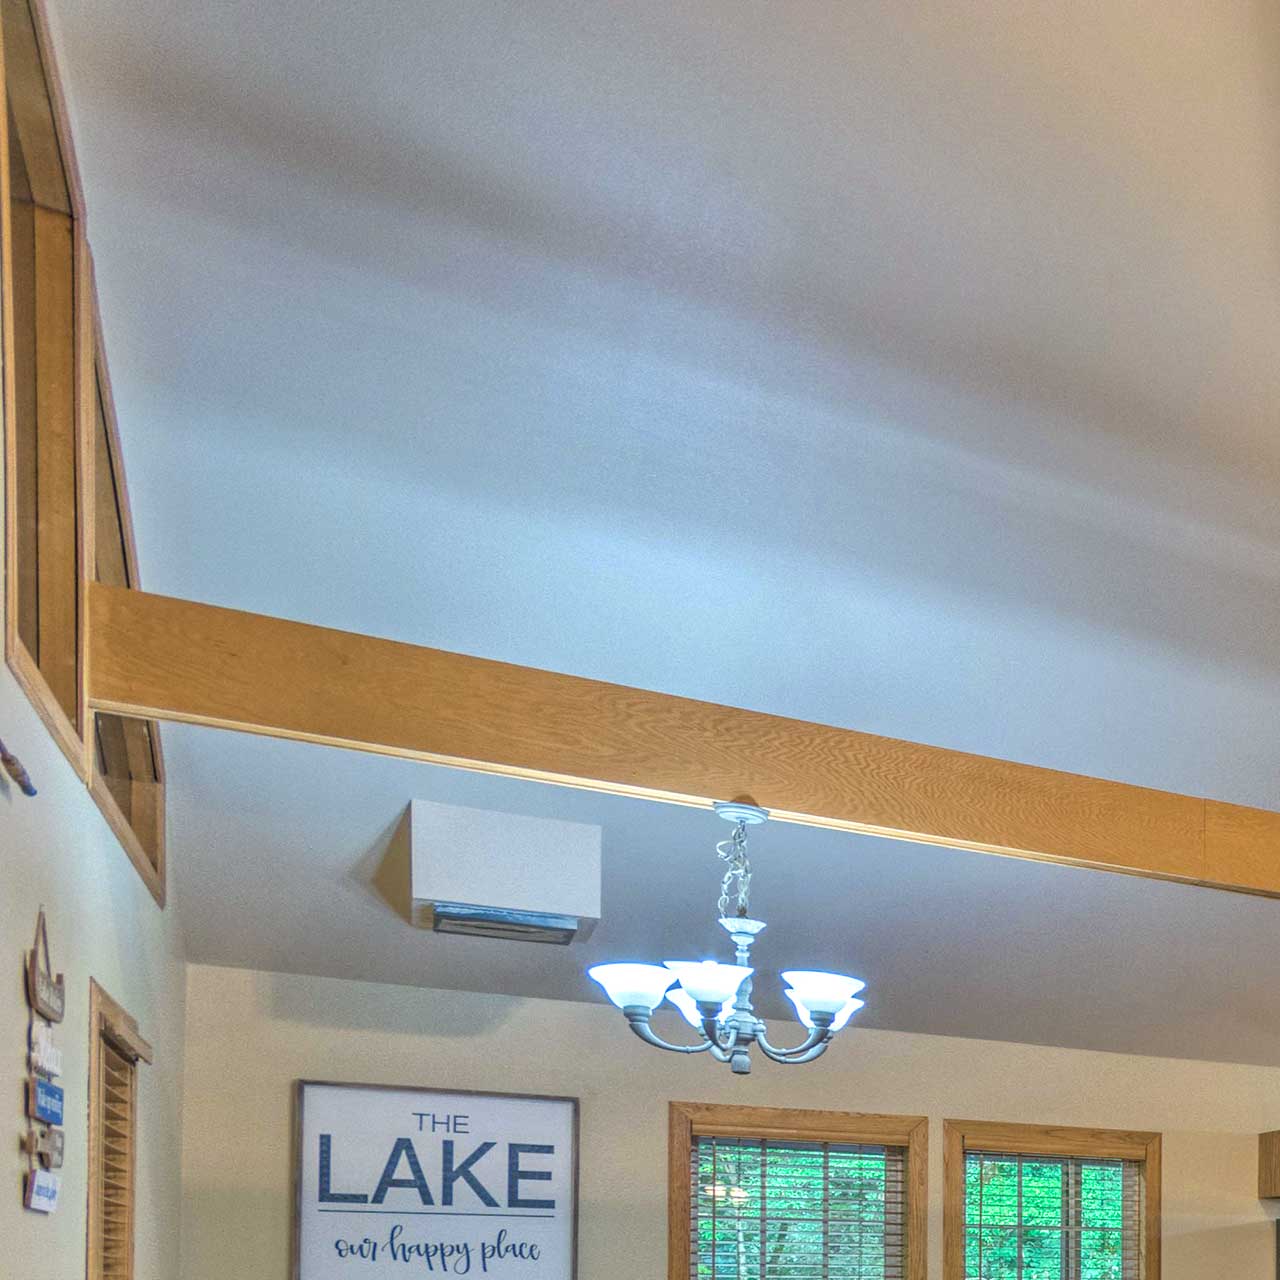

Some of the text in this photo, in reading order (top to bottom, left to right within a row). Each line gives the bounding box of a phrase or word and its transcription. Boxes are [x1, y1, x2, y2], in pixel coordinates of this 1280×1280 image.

[412, 1112, 470, 1134] THE
[318, 1133, 556, 1209] LAKE
[334, 1224, 541, 1275] our happy place
